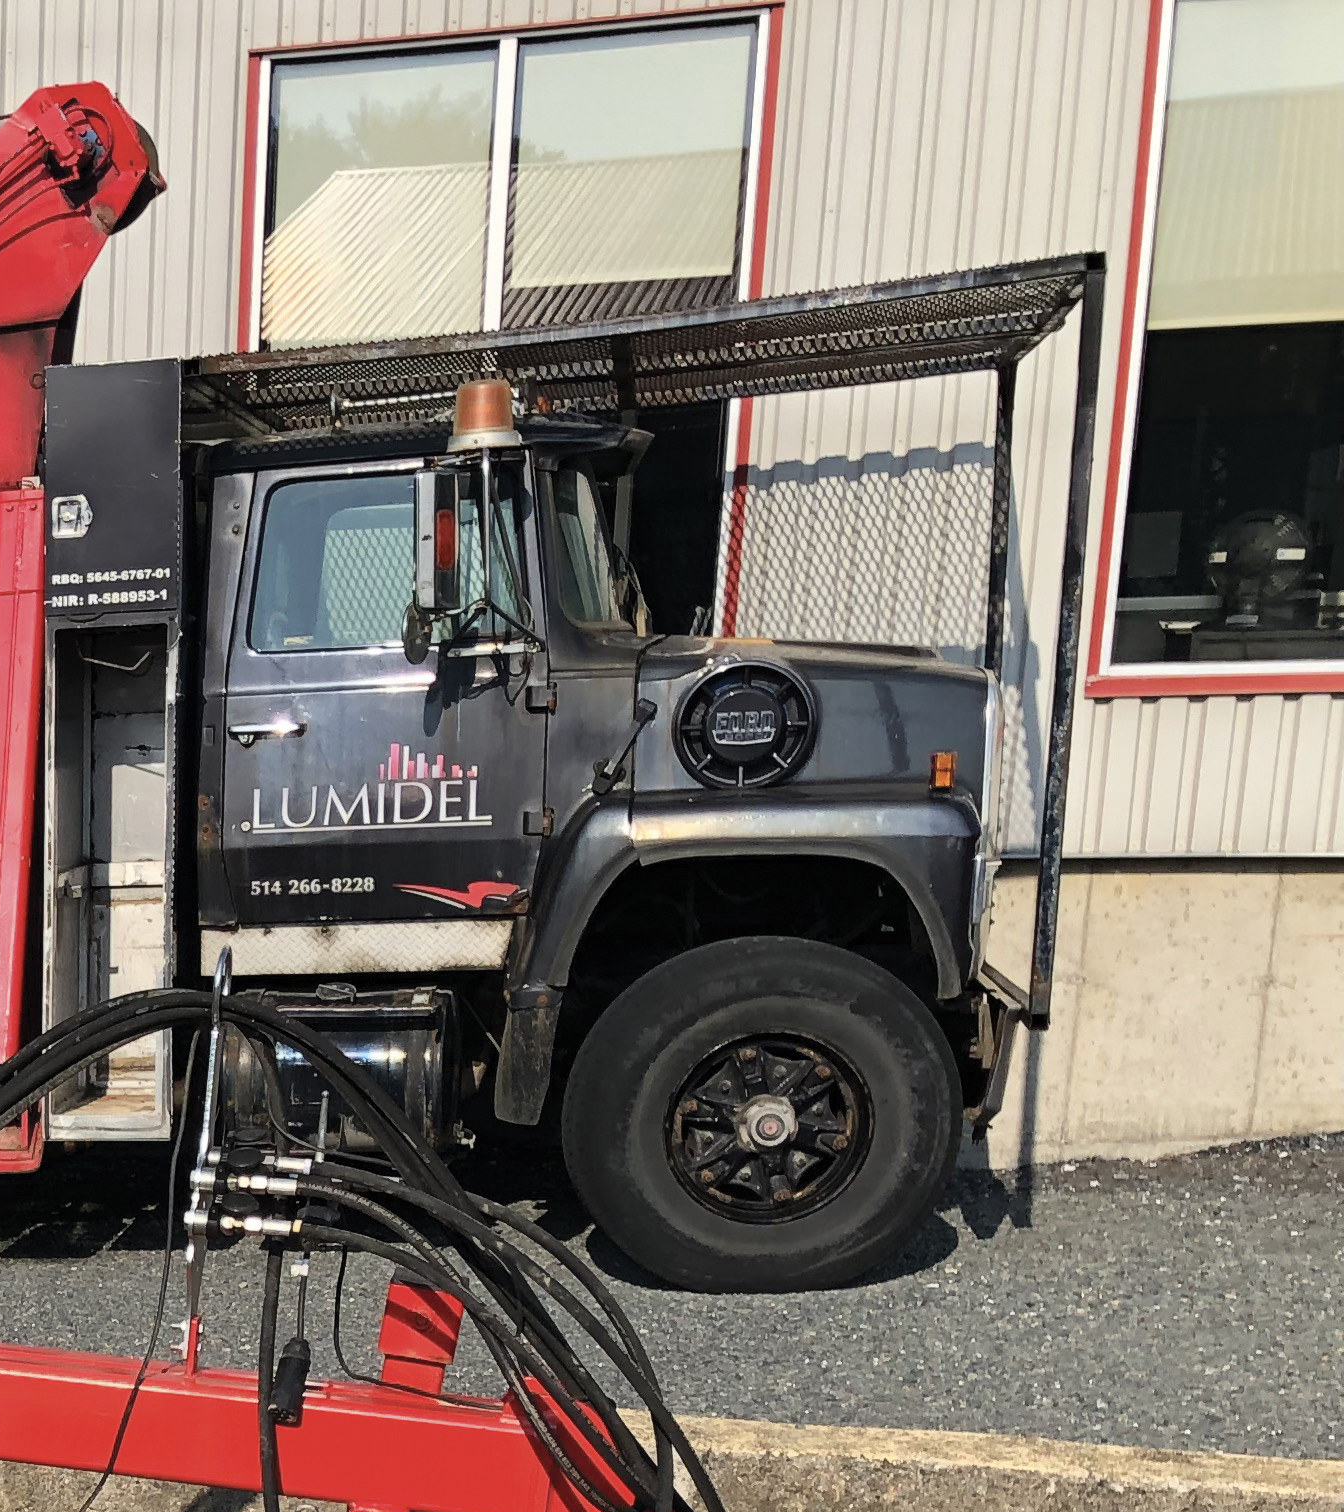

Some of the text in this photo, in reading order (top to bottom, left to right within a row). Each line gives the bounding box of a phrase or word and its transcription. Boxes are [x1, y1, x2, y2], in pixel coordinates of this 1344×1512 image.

[52, 567, 171, 585] RBQ: 5645-6767-01
[52, 588, 168, 607] NIR: R-588953-1
[253, 780, 493, 829] LUMIDEL
[250, 877, 376, 897] 514 266-8228
